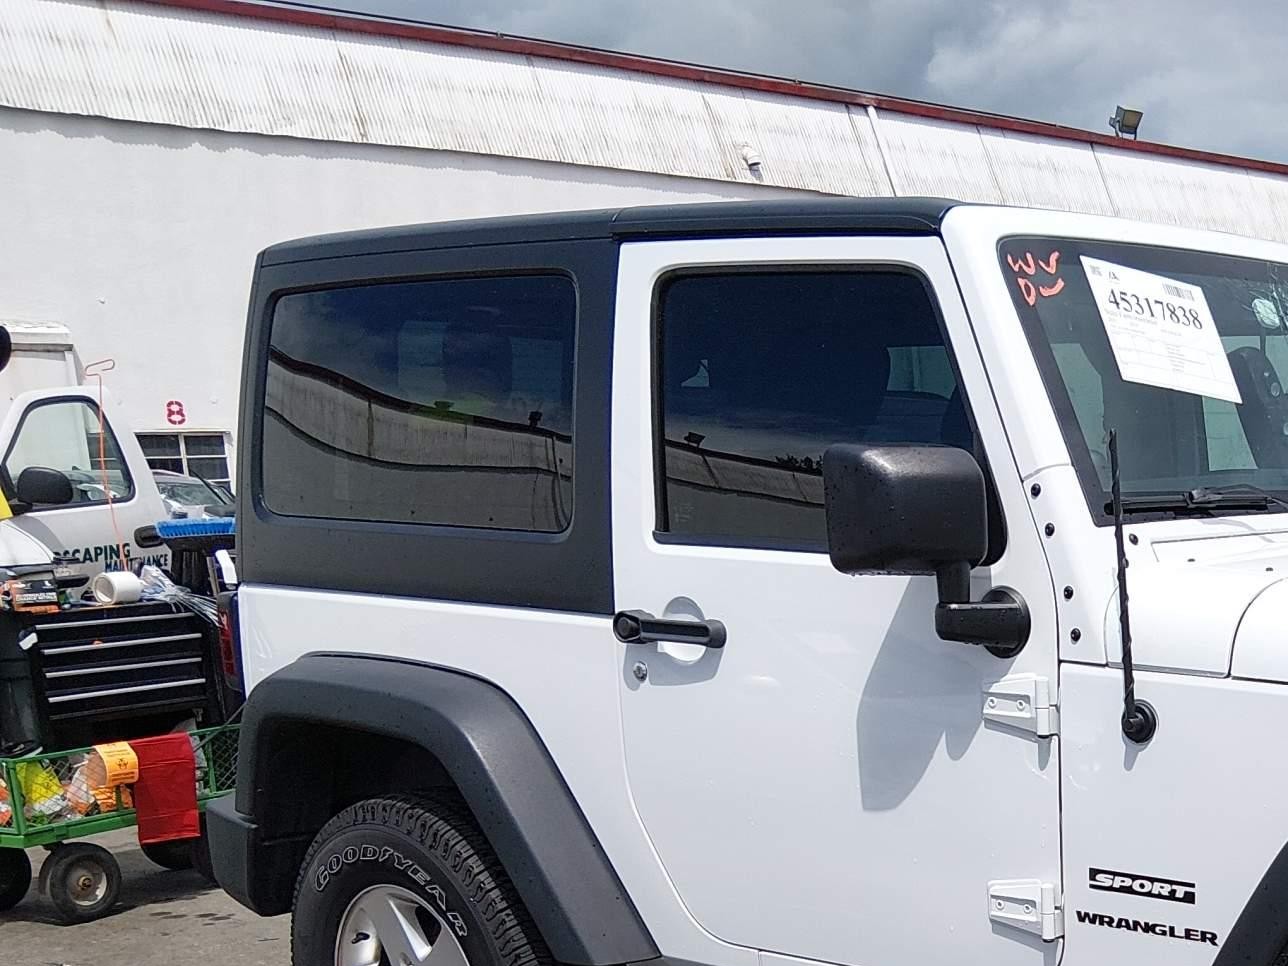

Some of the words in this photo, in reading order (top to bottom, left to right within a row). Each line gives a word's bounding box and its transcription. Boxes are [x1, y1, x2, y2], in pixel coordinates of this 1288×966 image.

[1108, 288, 1203, 330] 45317838
[166, 400, 186, 426] 8
[1092, 872, 1195, 900] SPORT
[1075, 910, 1219, 947] WRANGLER
